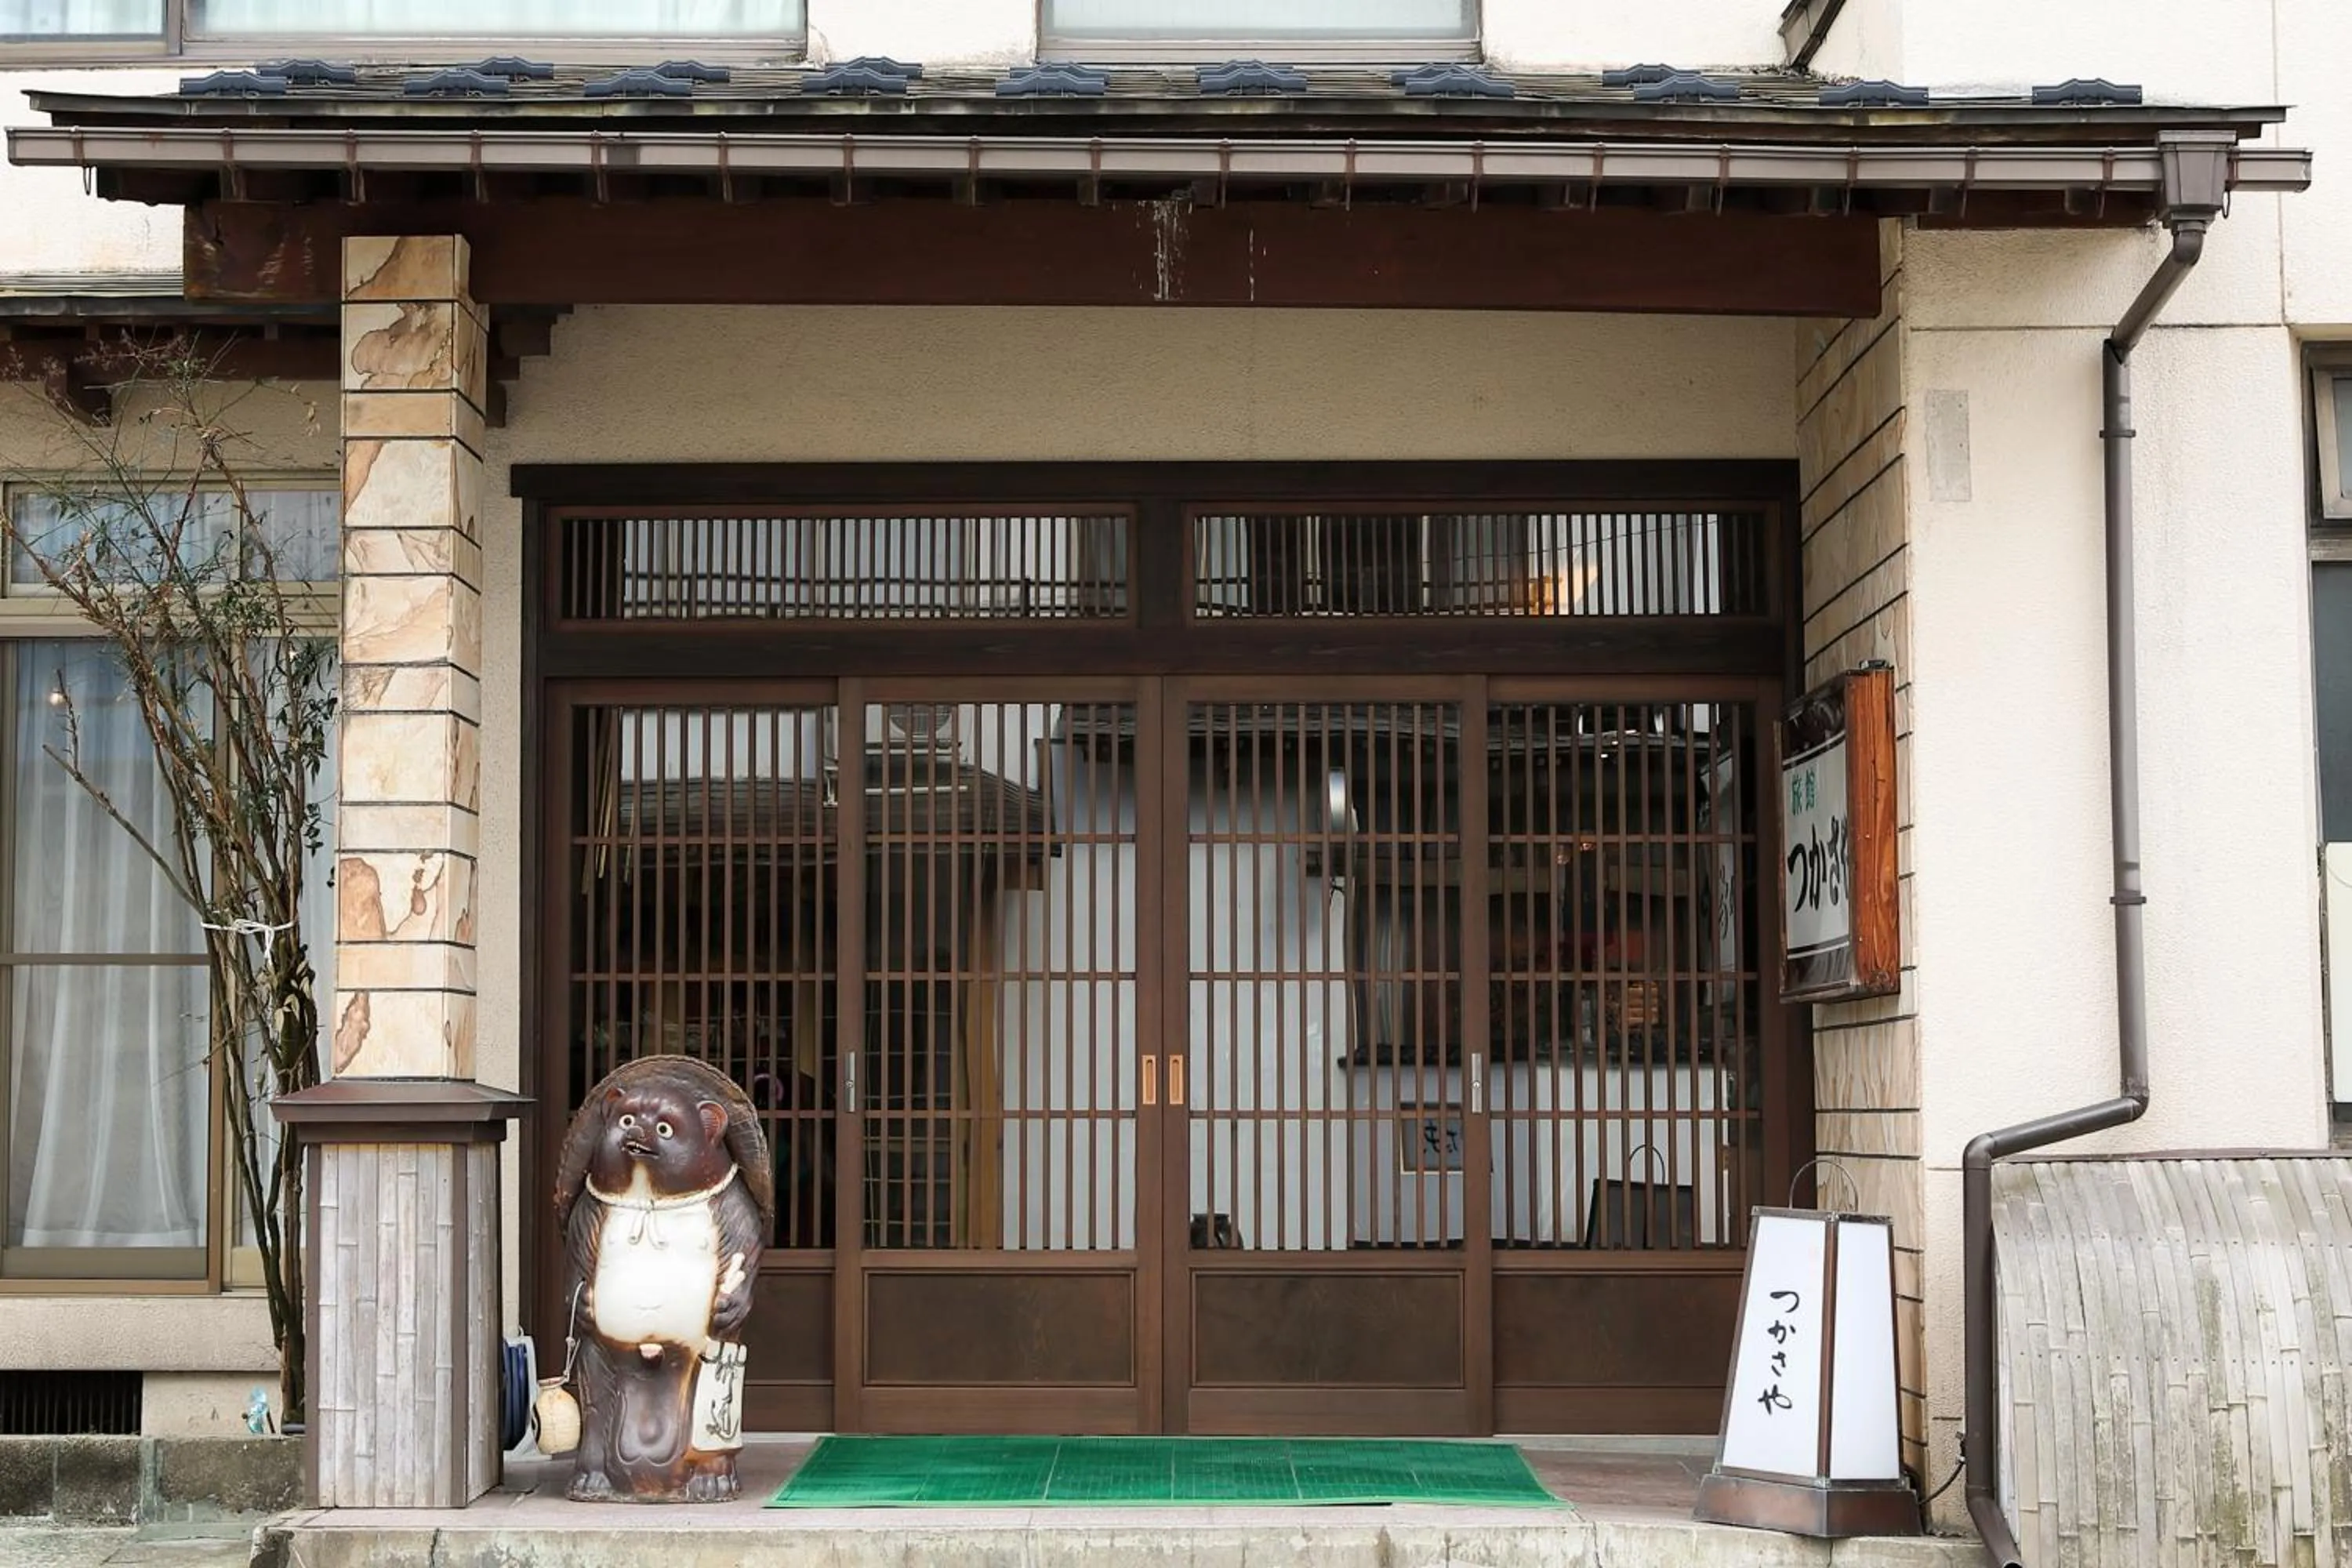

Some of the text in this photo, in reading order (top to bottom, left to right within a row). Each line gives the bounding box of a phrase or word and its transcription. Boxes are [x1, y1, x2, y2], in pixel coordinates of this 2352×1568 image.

[1791, 768, 1816, 815] 旅館
[1758, 1291, 1800, 1414] つかさや
